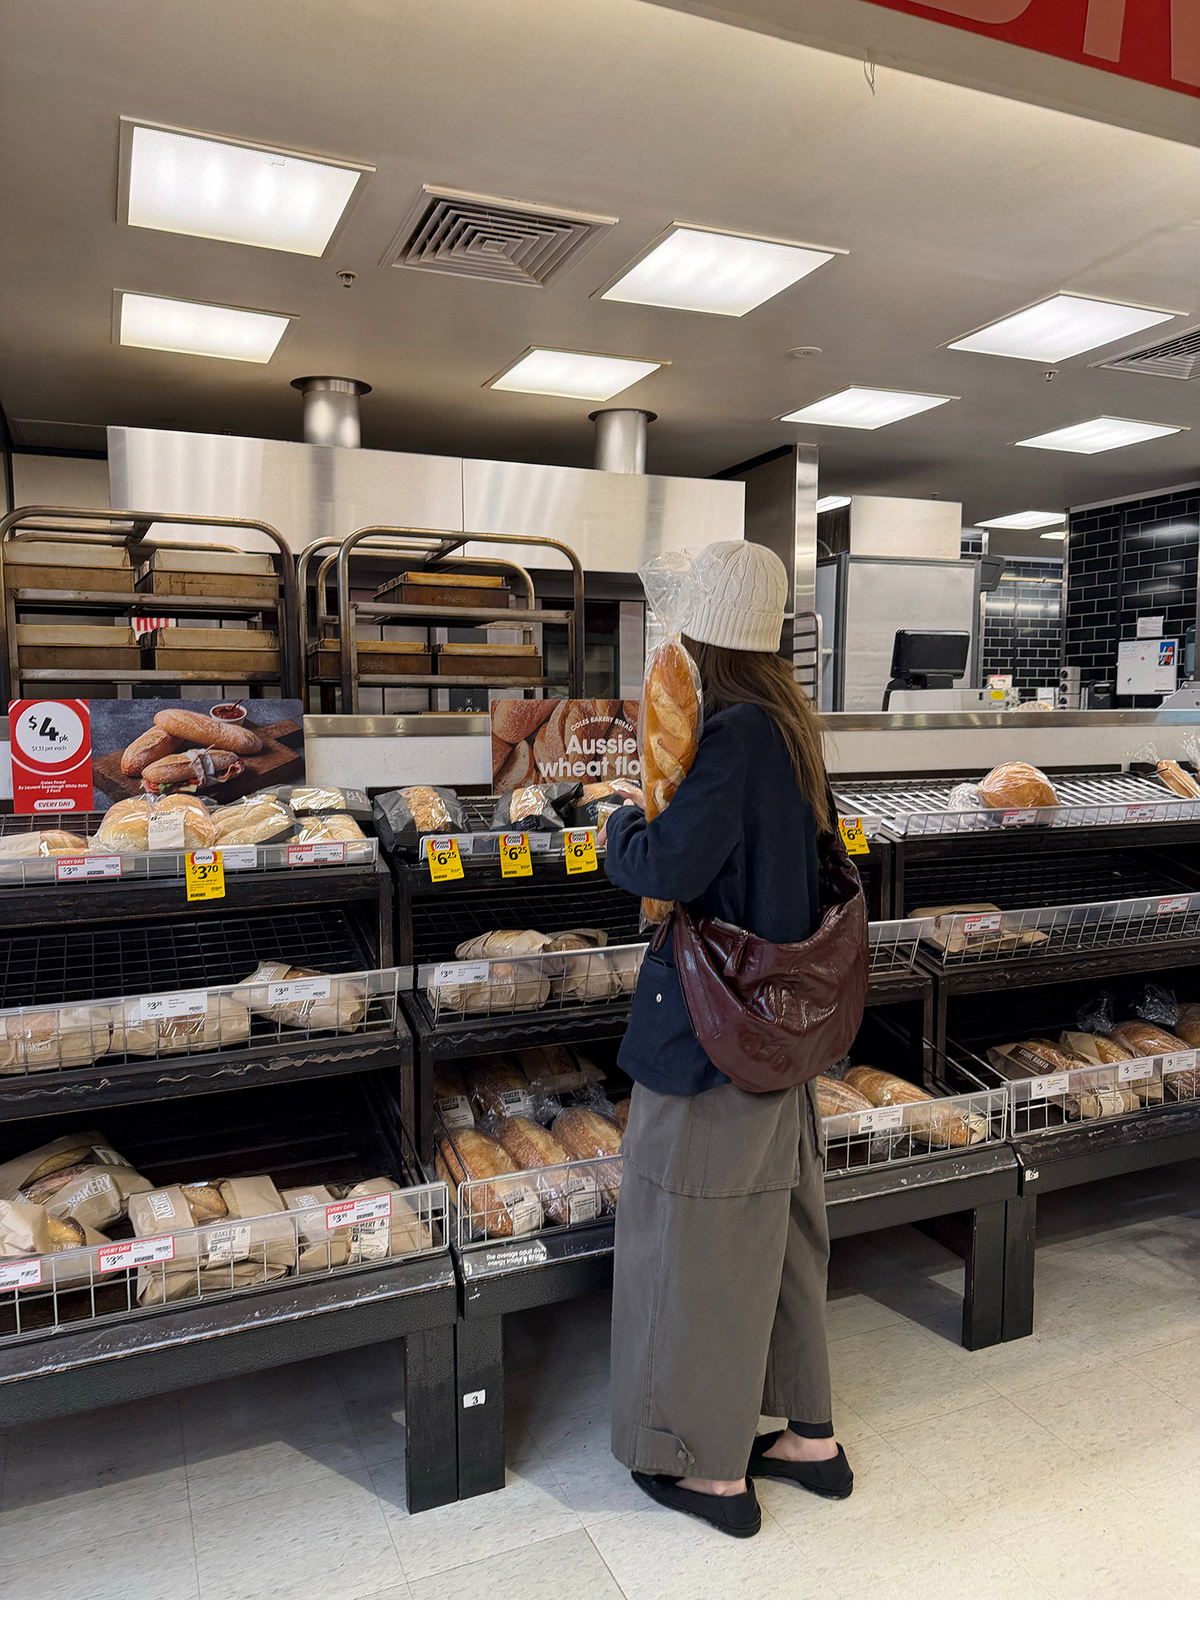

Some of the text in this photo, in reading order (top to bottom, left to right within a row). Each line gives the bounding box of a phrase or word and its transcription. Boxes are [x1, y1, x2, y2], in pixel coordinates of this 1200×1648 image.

[570, 718, 590, 732] COLES
[614, 718, 634, 732] BREAD
[566, 734, 637, 755] Aussie
[539, 756, 641, 777] wheat flo
[71, 1174, 112, 1207] BAKERY
[150, 1193, 174, 1220] BAKERY
[100, 1244, 131, 1255] EVERY DAY
[496, 1251, 518, 1259] average
[471, 1395, 479, 1405] 3
